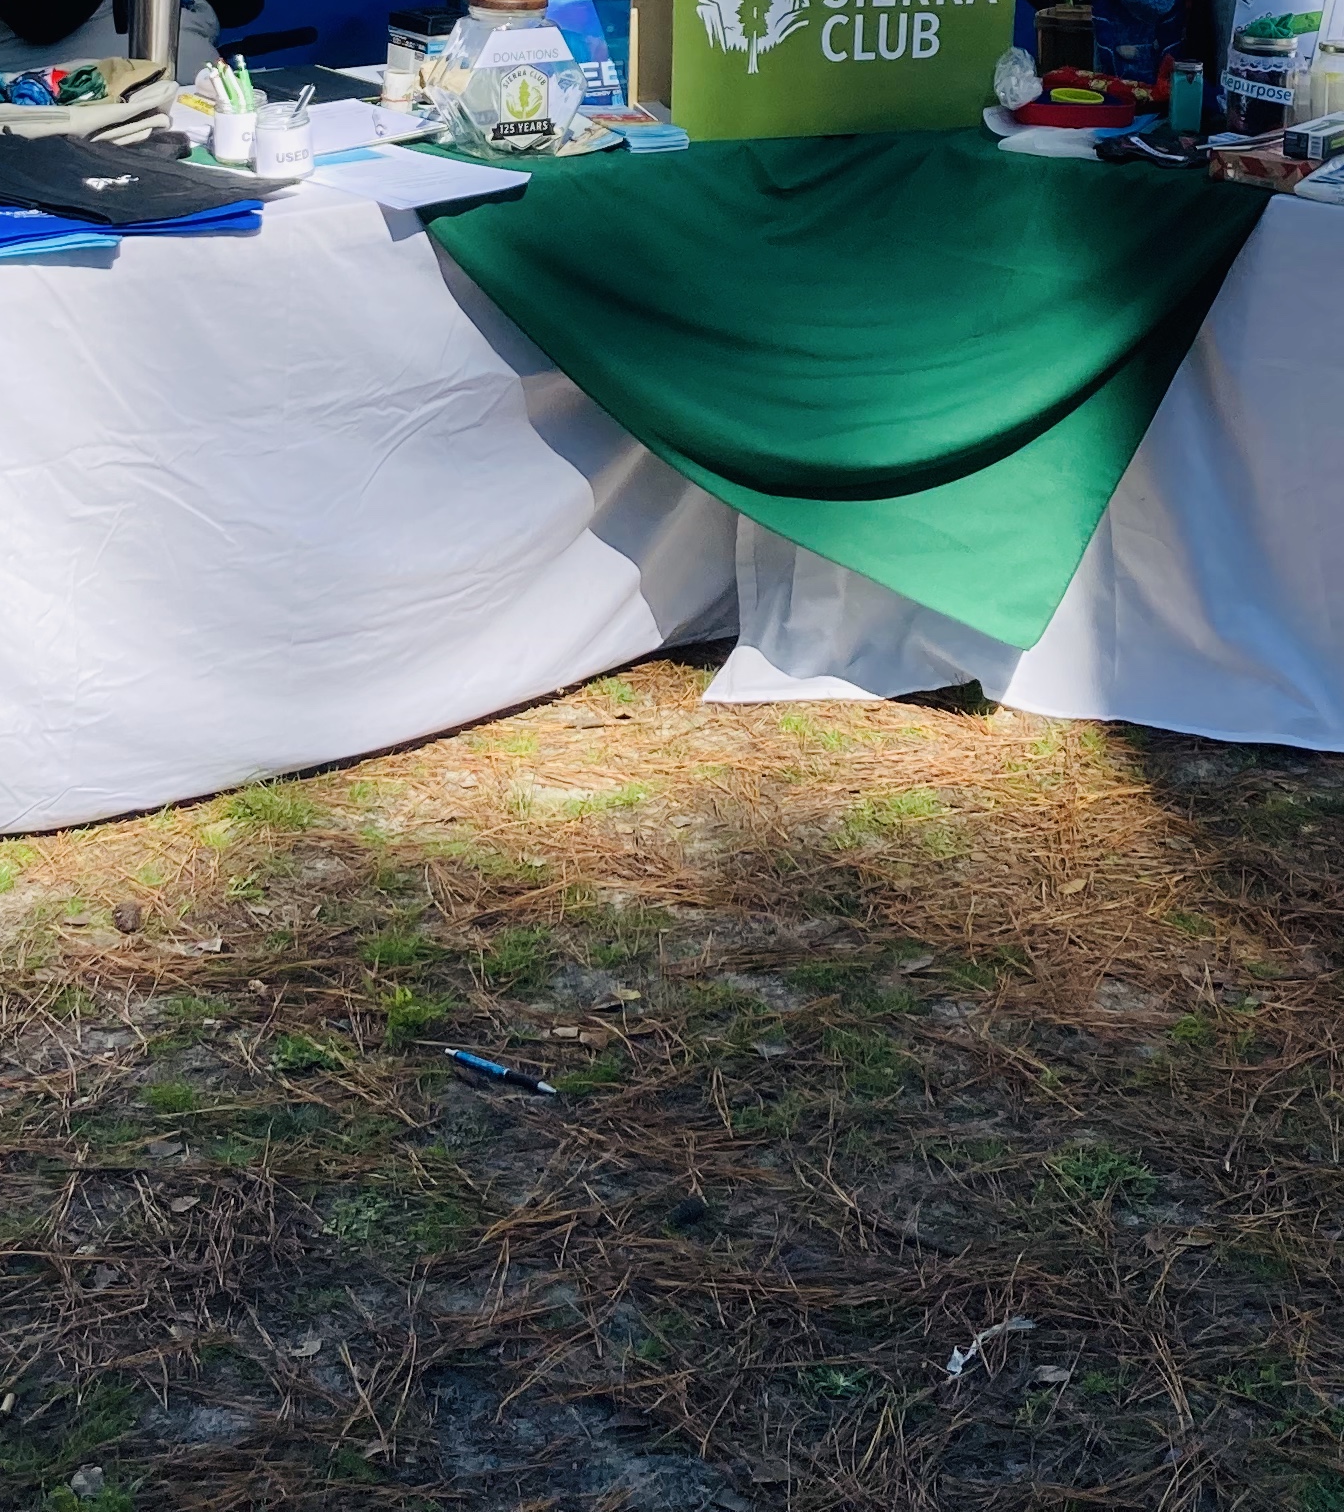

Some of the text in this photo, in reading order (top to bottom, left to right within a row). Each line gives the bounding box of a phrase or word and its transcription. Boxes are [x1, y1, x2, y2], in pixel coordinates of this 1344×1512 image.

[821, 12, 940, 62] CLUB
[493, 48, 559, 63] DONATIONS
[502, 69, 547, 90] SIERRA CLUB
[499, 120, 549, 135] 125 YEARS
[275, 148, 310, 164] USED
